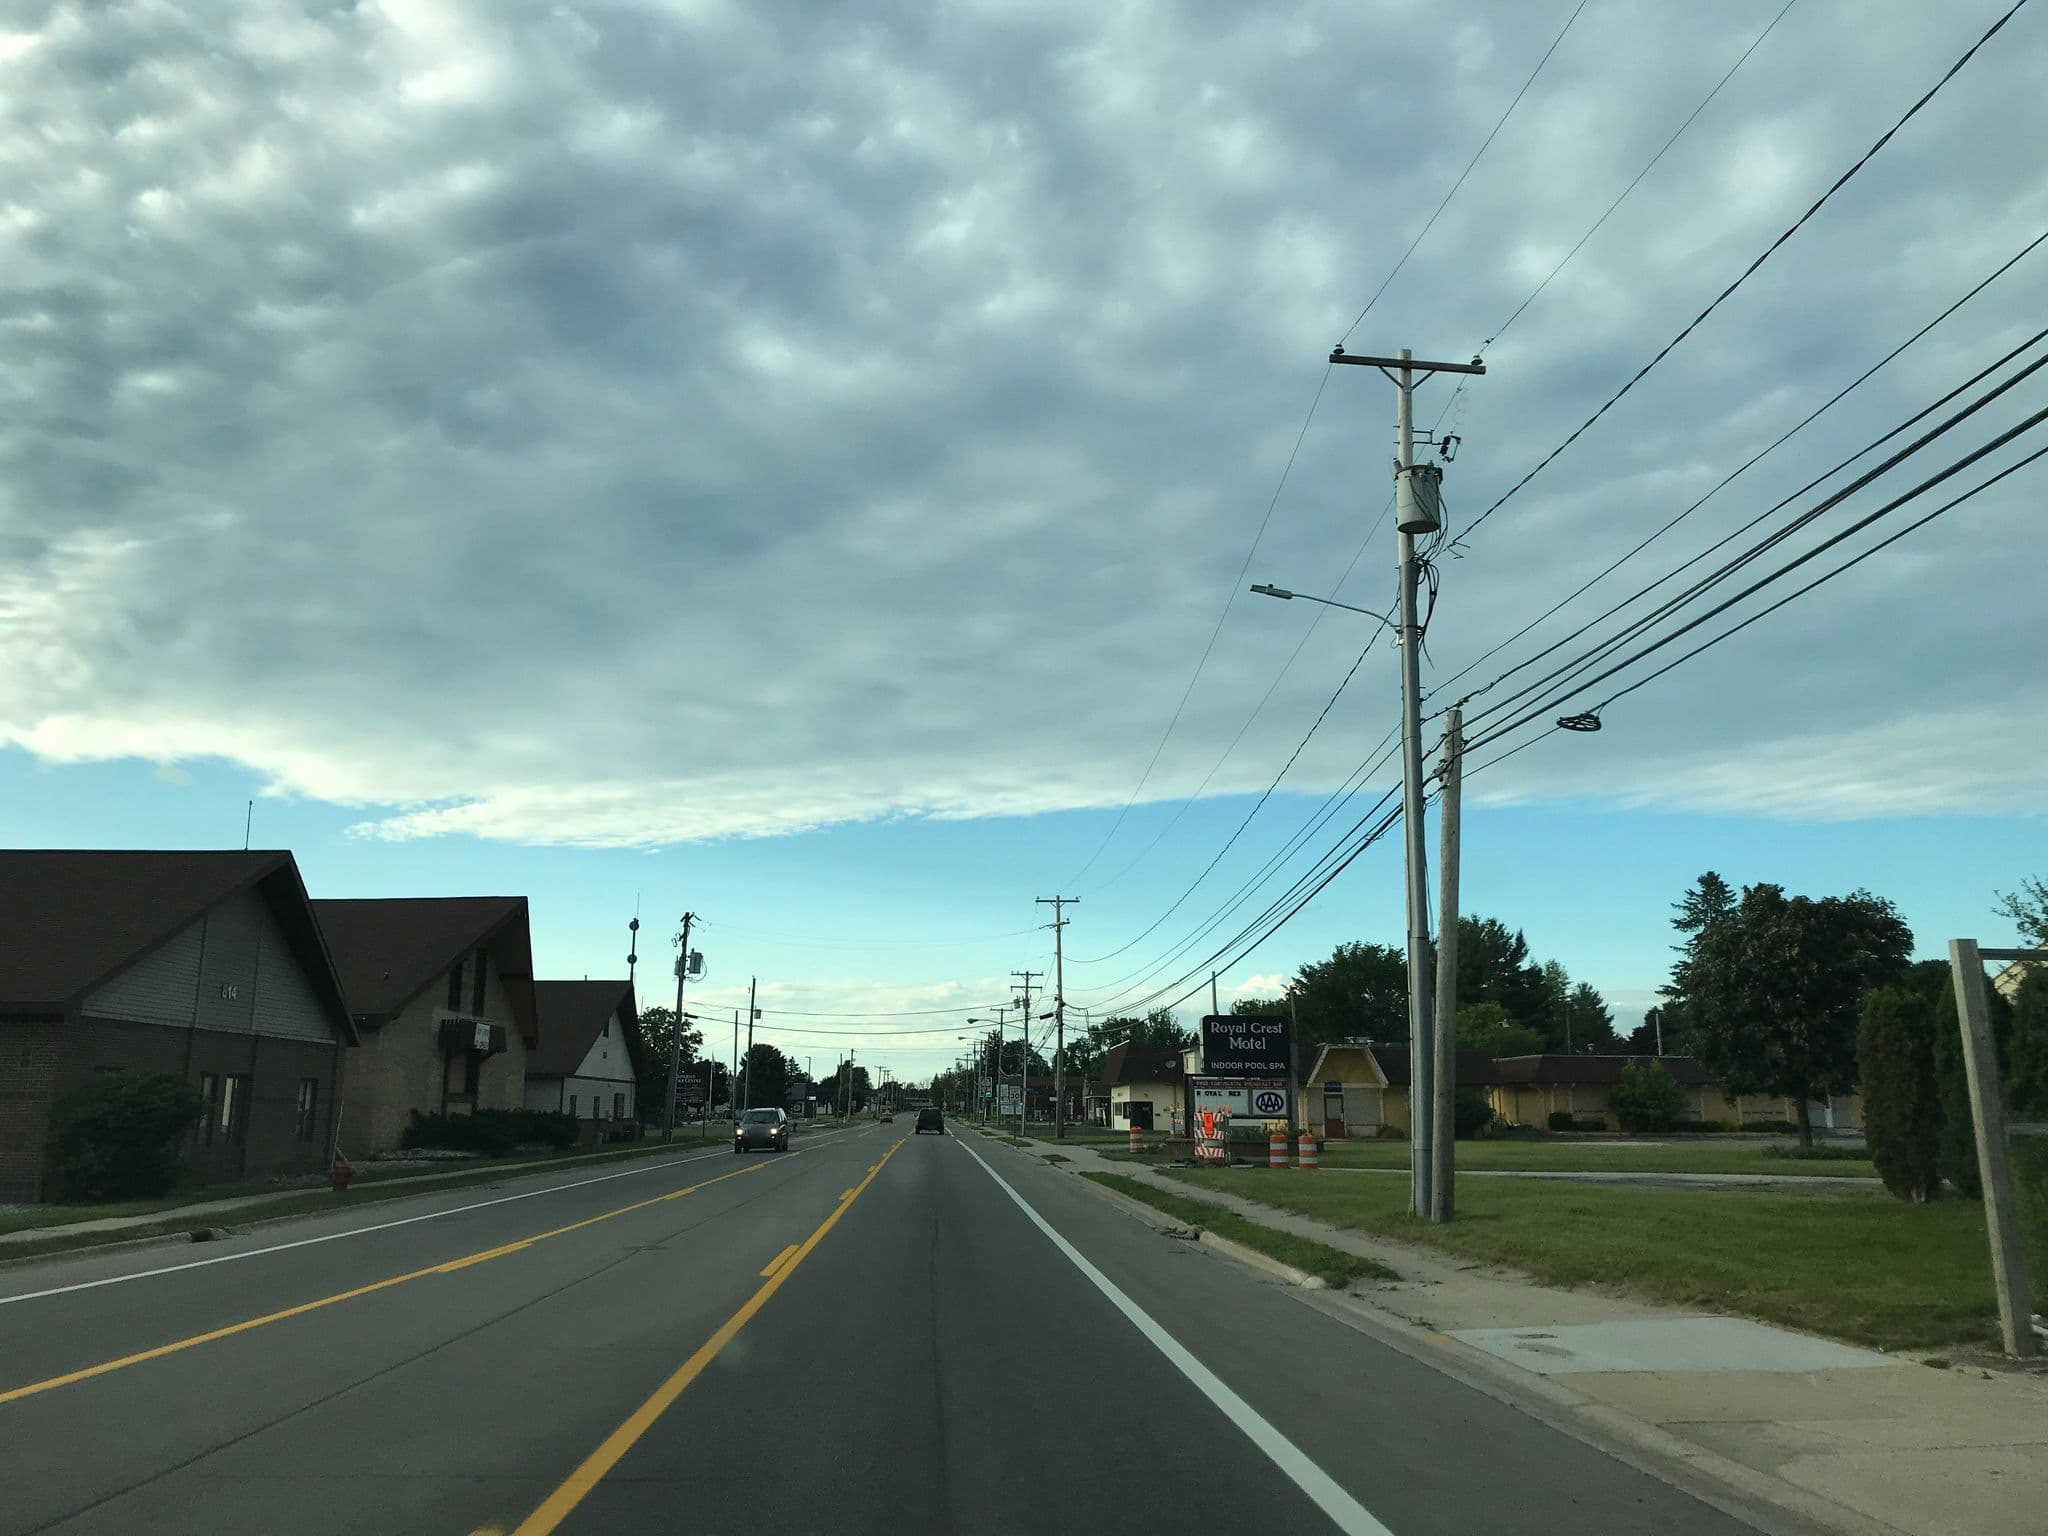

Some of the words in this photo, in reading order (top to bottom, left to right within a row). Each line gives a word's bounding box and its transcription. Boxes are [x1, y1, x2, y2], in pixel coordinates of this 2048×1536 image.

[1210, 1022, 1246, 1036] Royal
[1250, 1022, 1283, 1034] Crest
[1229, 1036, 1267, 1050] Motel
[1211, 1062, 1243, 1070] INDOOR
[1245, 1062, 1268, 1070] POOL
[1269, 1062, 1286, 1070] SPA
[1257, 1094, 1281, 1111] AAA
